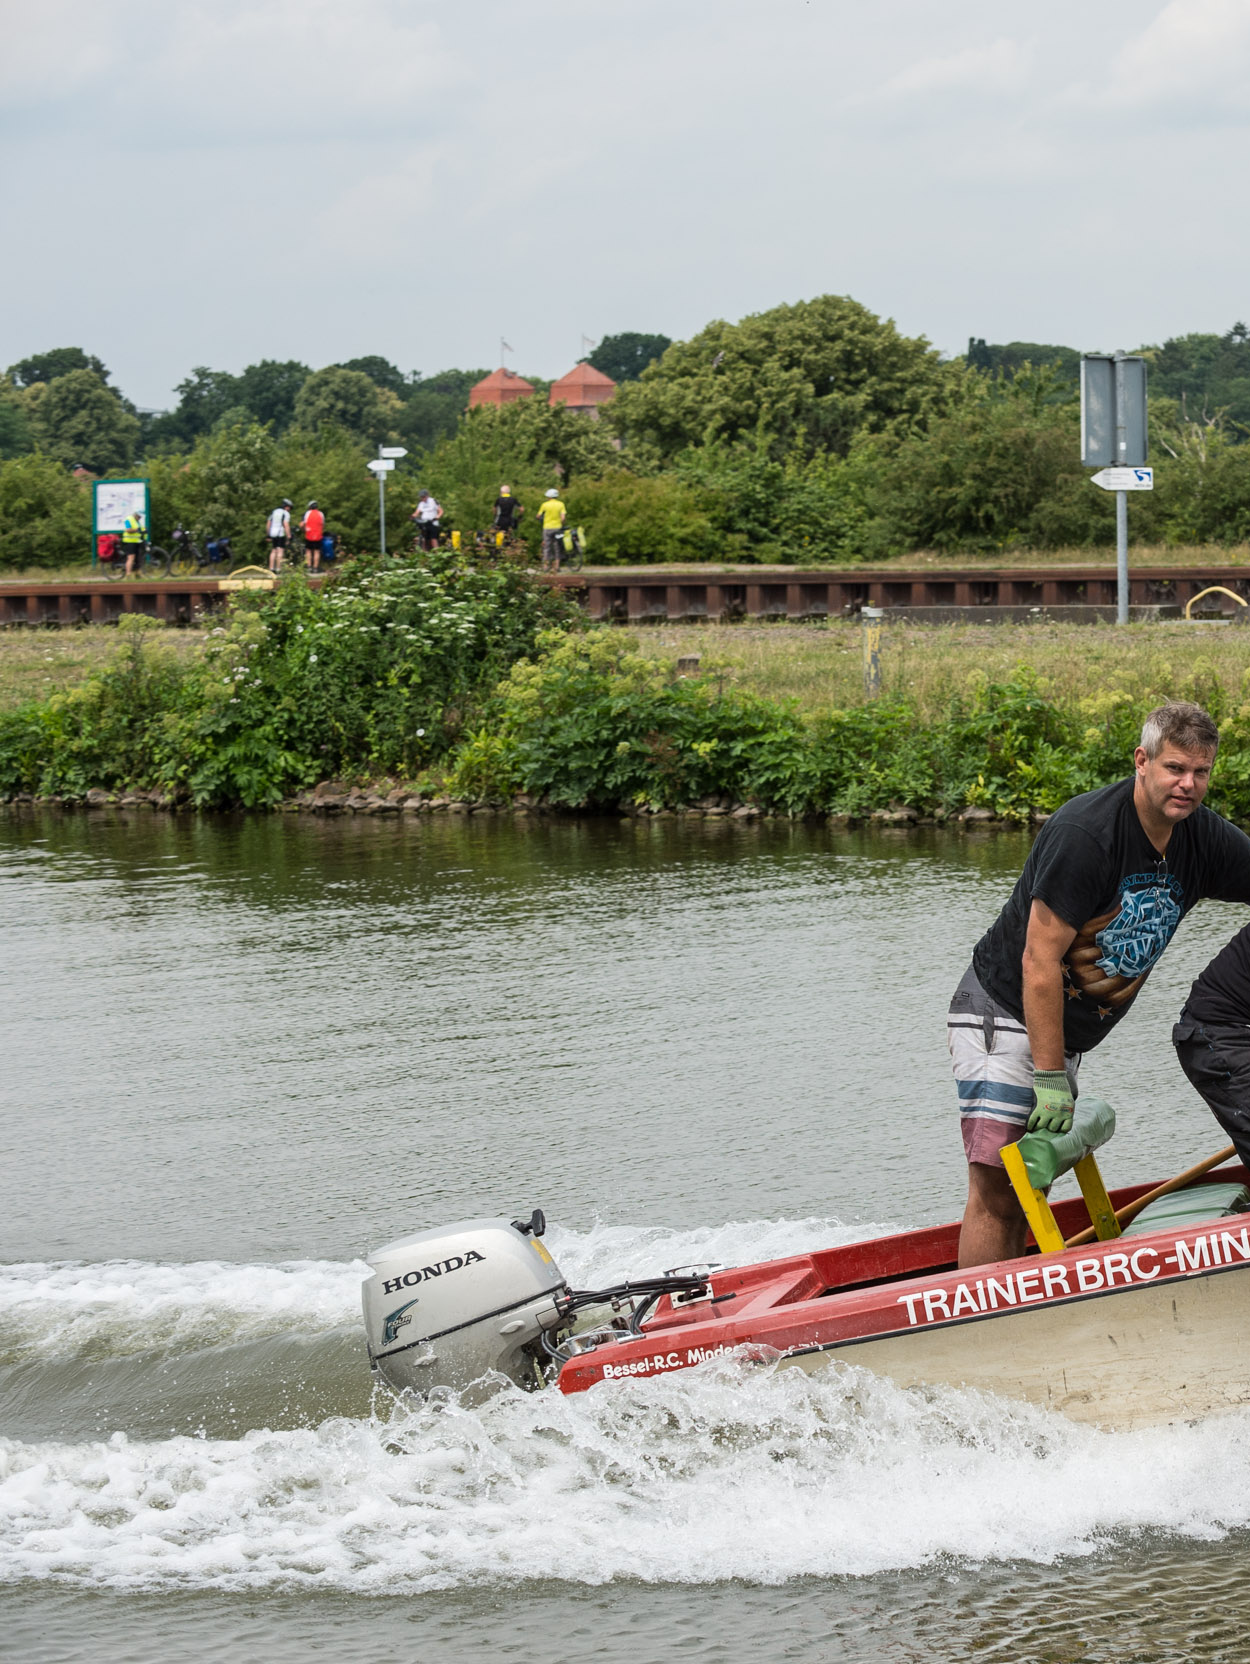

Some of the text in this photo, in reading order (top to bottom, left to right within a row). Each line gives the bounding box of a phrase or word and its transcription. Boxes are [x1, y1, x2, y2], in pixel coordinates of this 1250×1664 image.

[382, 1249, 486, 1295] HONDA
[897, 1264, 1071, 1325] TRAINER
[602, 1353, 683, 1379] Bessel-R.C.
